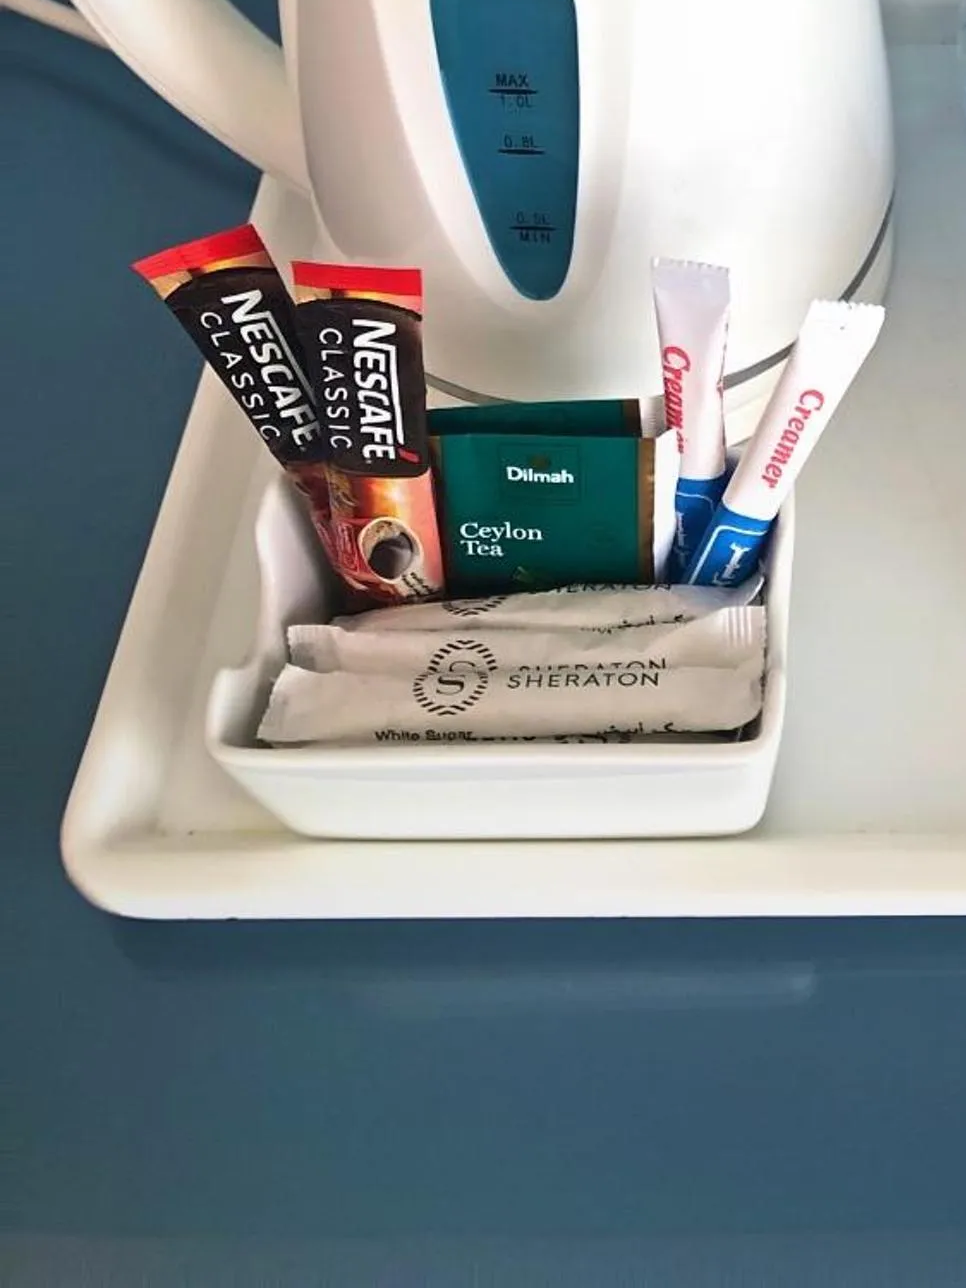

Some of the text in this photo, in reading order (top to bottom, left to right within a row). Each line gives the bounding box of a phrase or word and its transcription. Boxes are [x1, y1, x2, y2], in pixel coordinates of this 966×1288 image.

[495, 73, 529, 88] MAX
[520, 231, 551, 244] MIN
[200, 312, 281, 440] CLASSIC
[319, 327, 352, 449] CLASSIC
[761, 389, 825, 489] Creamer
[505, 466, 574, 483] Dilmah
[459, 521, 543, 542] Ceylon
[459, 540, 505, 557] Tea
[506, 672, 659, 689] SHERATON
